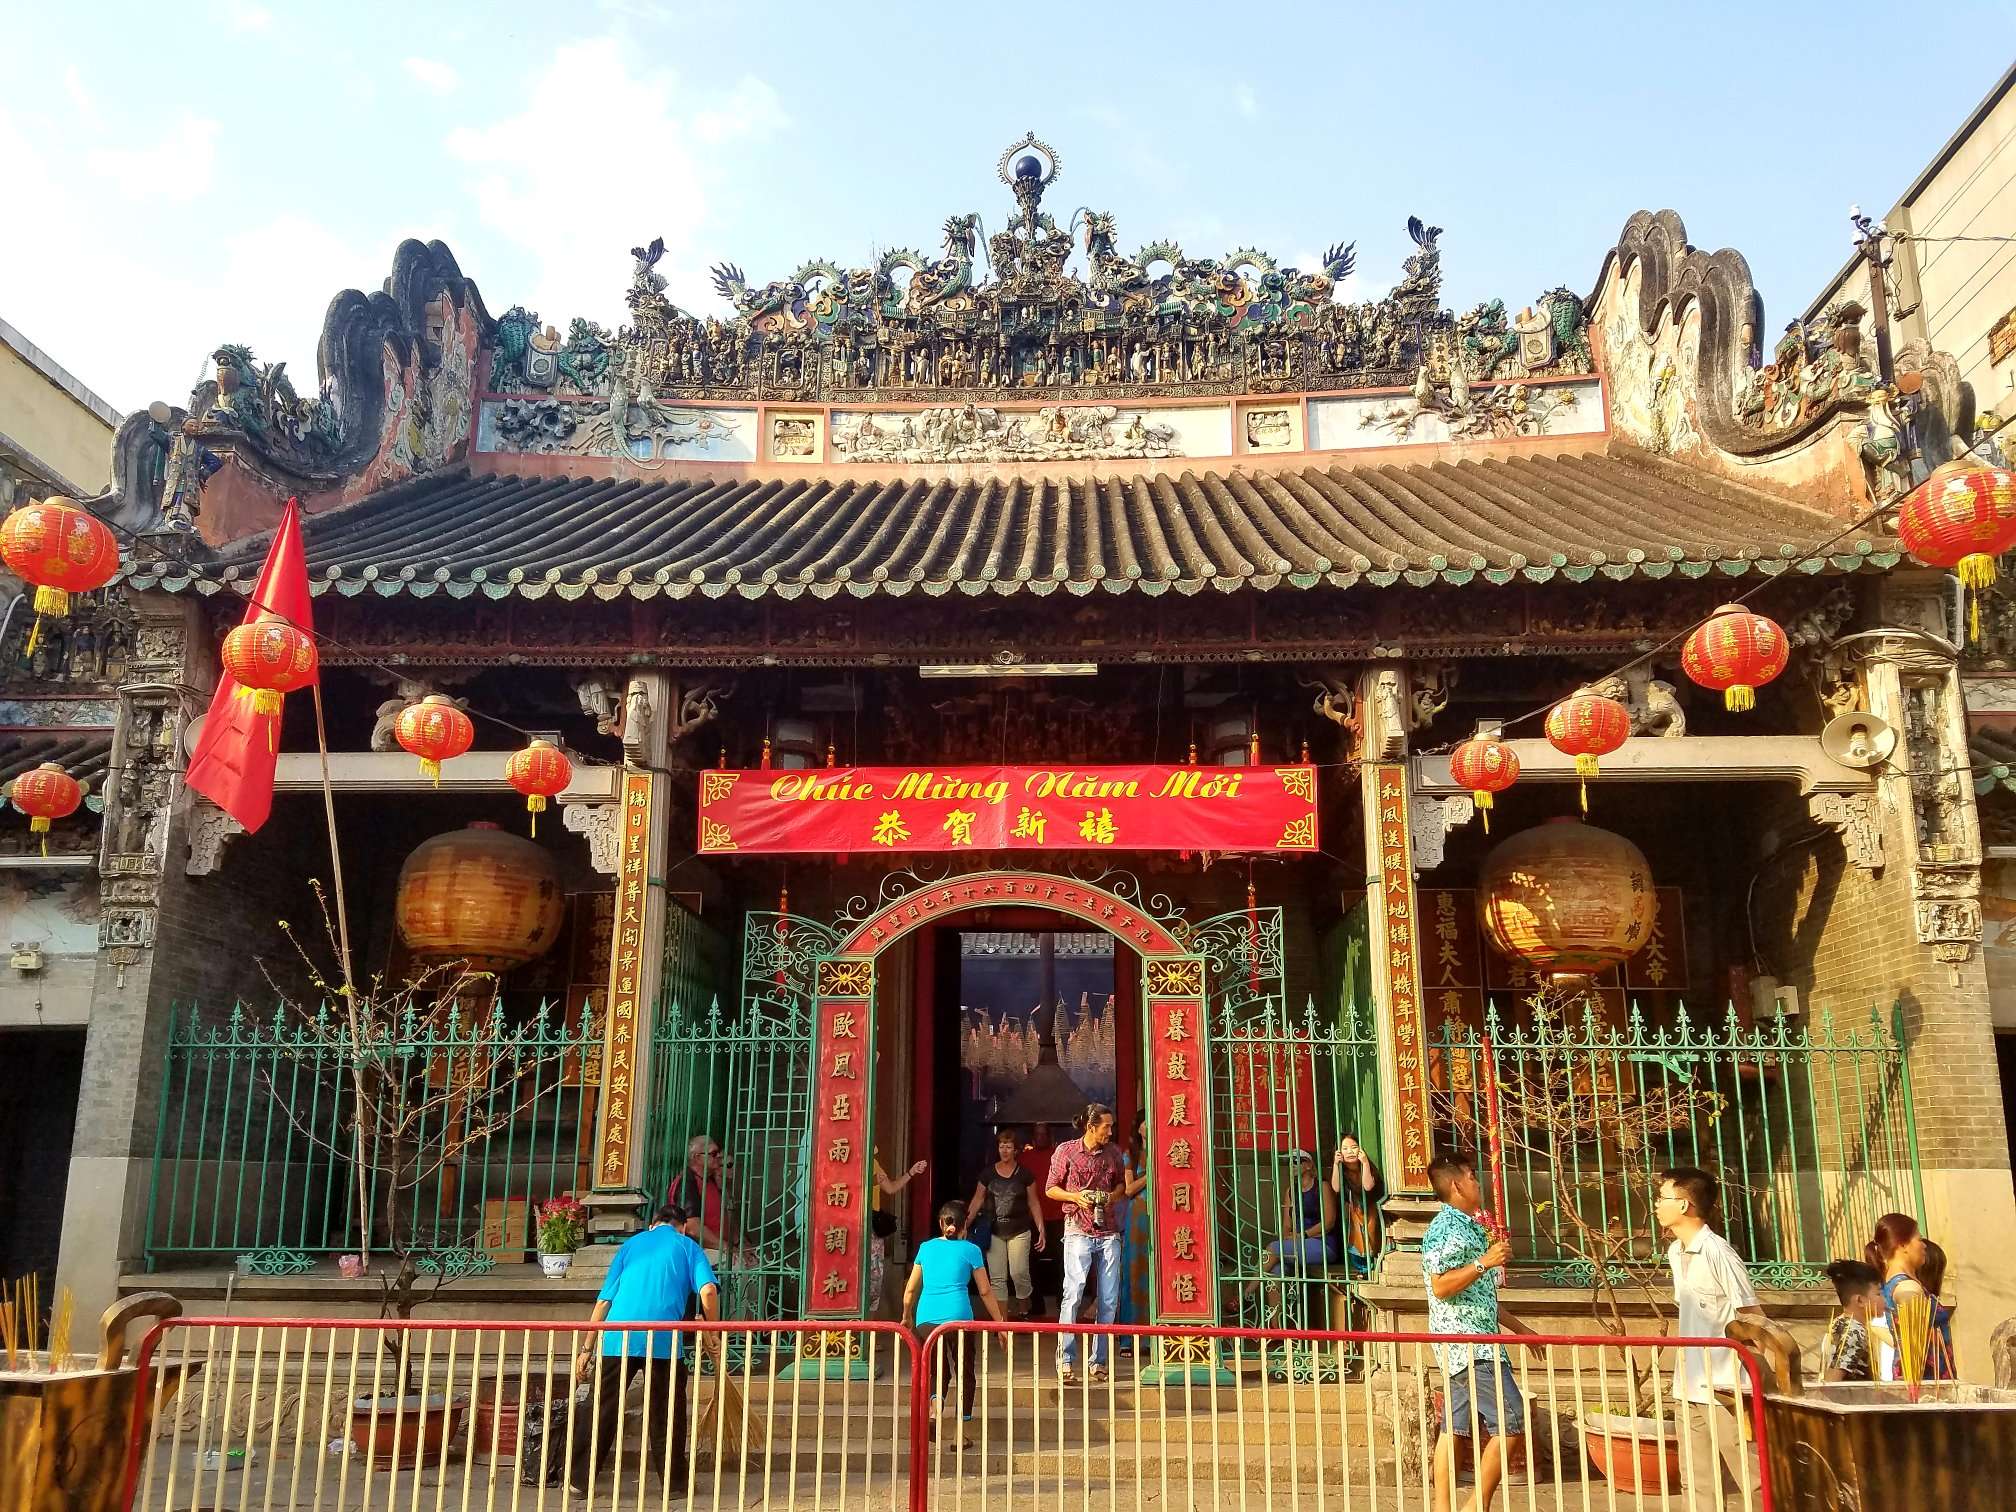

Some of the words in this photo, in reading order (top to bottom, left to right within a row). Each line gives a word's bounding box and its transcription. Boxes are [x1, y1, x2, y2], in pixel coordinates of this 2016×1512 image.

[770, 773, 874, 802] Chúc
[881, 773, 1012, 806] Mừng
[1024, 771, 1141, 798] Năm
[1150, 770, 1244, 798] Mới
[871, 808, 1119, 847] 恭賀新禧
[1435, 892, 1465, 988] 惠福夫人
[1164, 1009, 1198, 1303] 暮鼓晨鐘同覺悟
